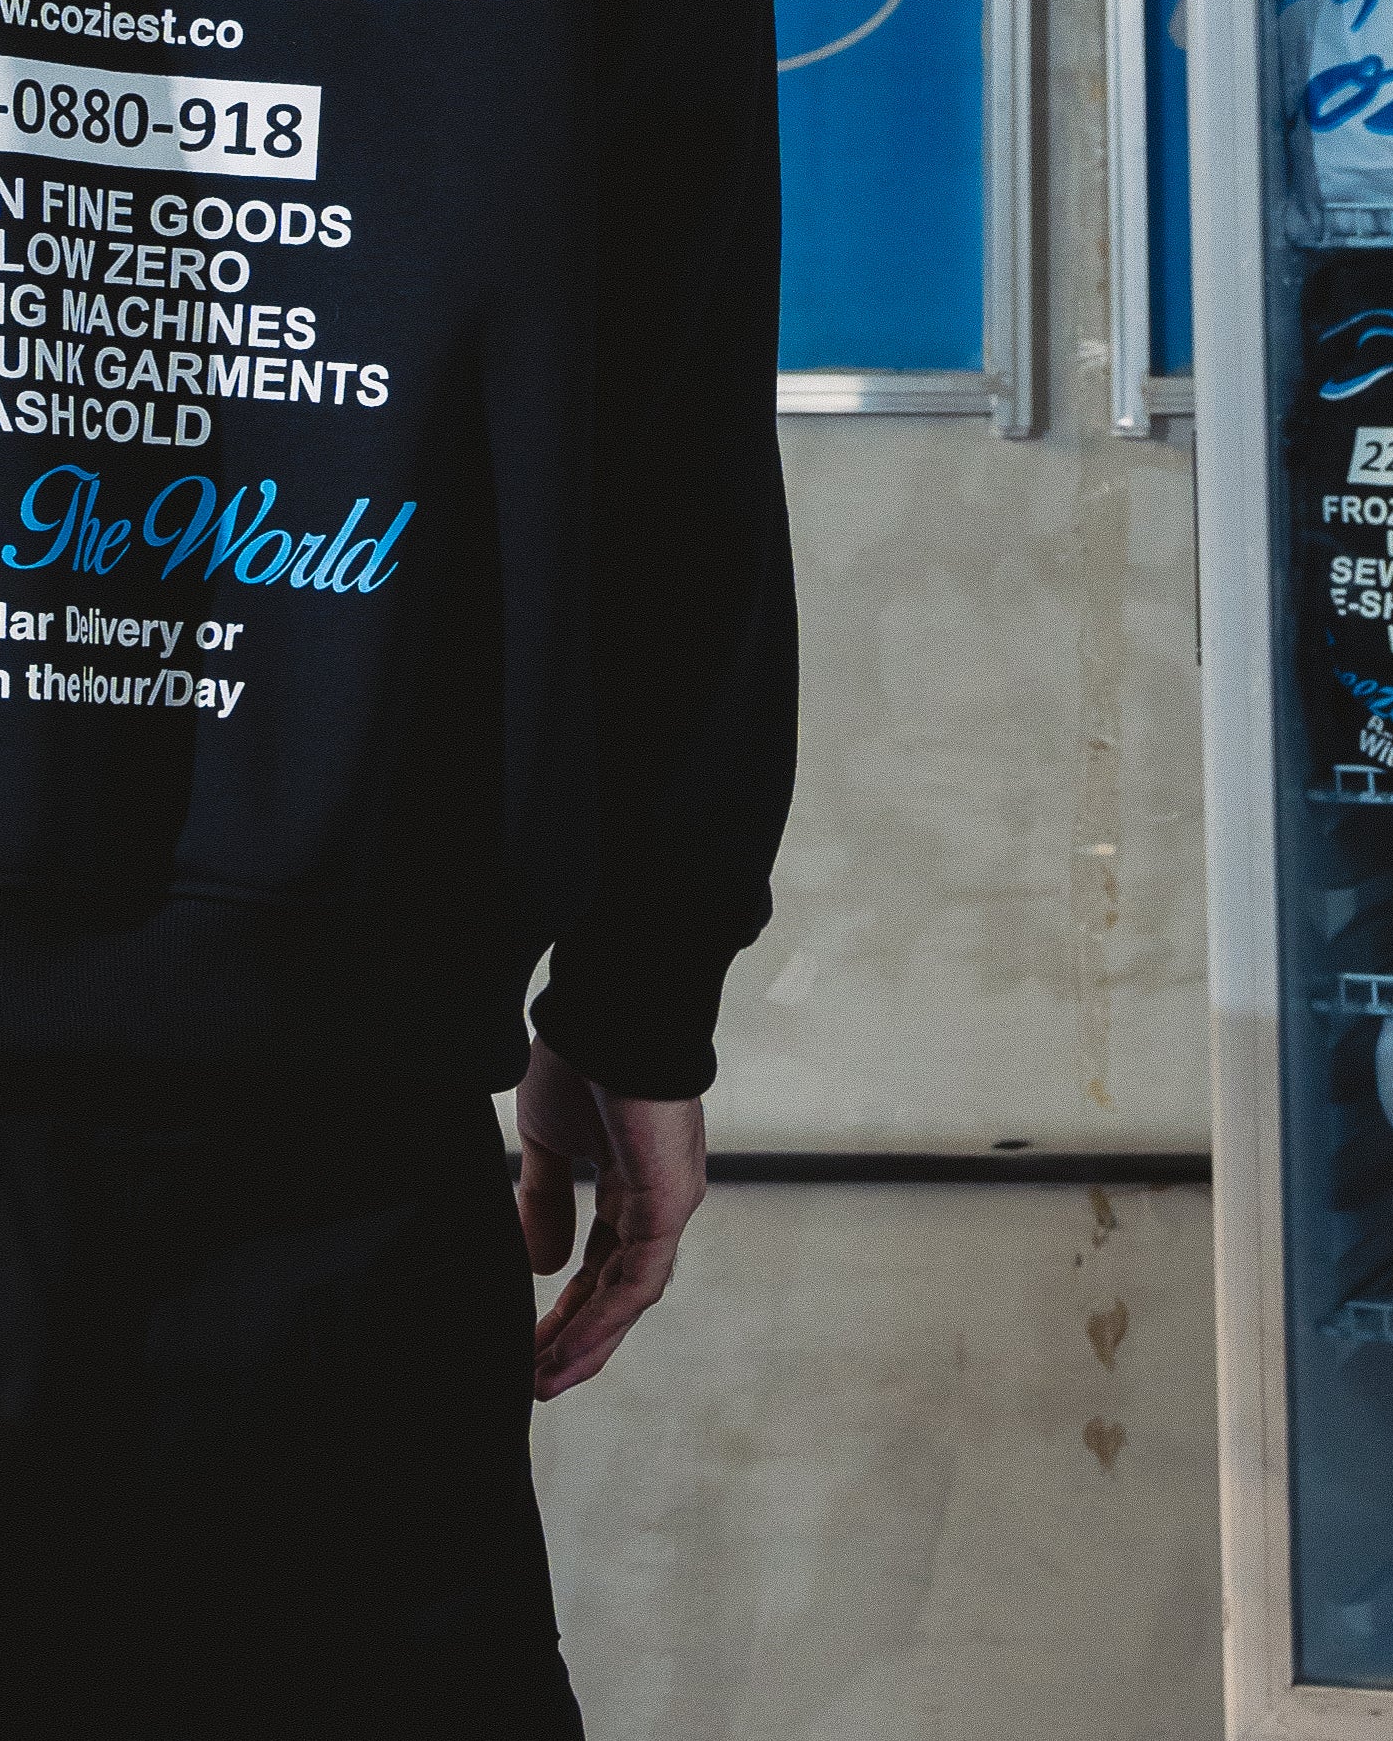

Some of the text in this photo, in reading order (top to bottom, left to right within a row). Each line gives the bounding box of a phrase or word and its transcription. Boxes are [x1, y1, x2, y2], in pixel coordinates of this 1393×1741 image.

[43, 181, 133, 233] FINE
[150, 194, 353, 248] GOODS
[104, 242, 250, 294] ZERO
[63, 289, 317, 351] MACHINES
[94, 346, 390, 408] GARMENTS
[82, 397, 211, 447] COLD
[1, 465, 132, 575] The
[143, 475, 417, 594] World
[66, 605, 184, 659] Delivery
[196, 621, 244, 651] or
